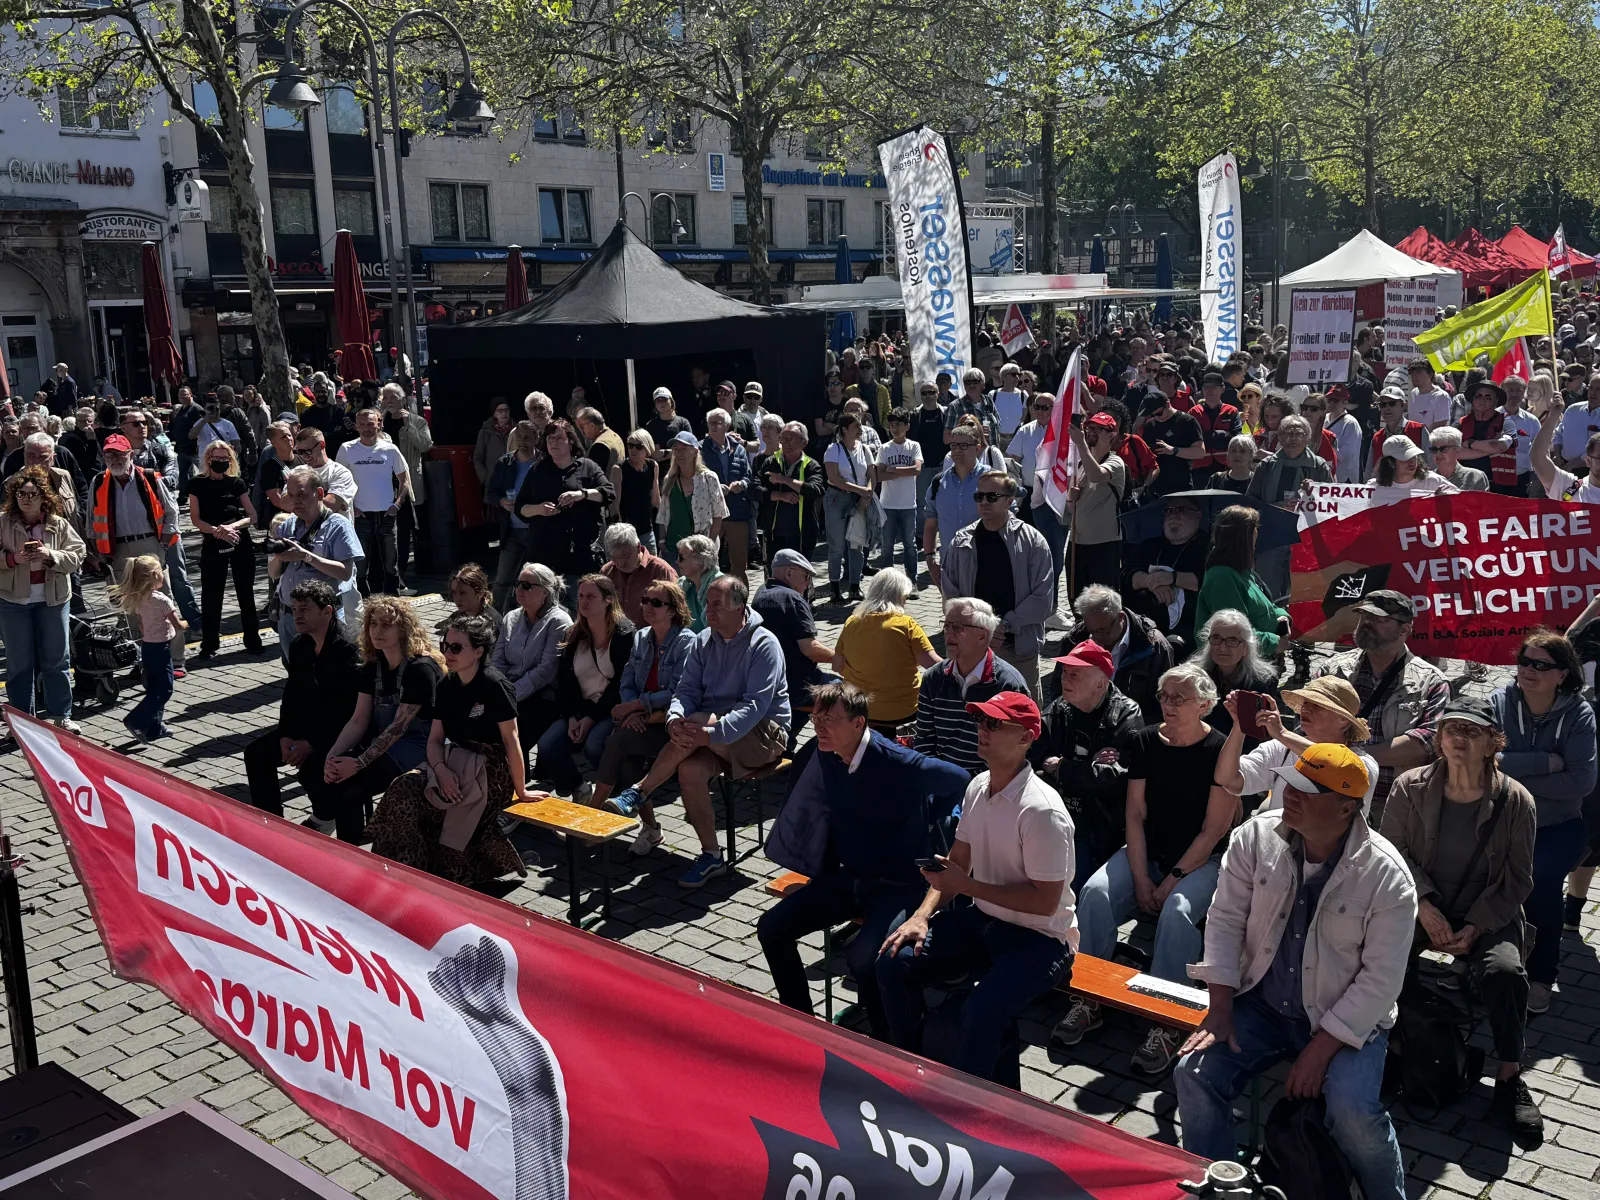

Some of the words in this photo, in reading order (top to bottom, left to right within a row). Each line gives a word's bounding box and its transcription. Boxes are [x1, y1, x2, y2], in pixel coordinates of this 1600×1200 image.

[77, 159, 135, 187] MILANO
[84, 216, 156, 231] RISTORANTE
[96, 228, 147, 239] PIZZERIA
[1418, 280, 1436, 291] Krieg
[1386, 292, 1402, 302] Nein
[1403, 294, 1415, 302] zur
[1416, 295, 1436, 303] neuen
[1413, 306, 1423, 315] der
[1291, 332, 1320, 345] Freiheit
[1324, 332, 1336, 344] für
[1338, 331, 1351, 344] Alle
[1386, 330, 1398, 339] des
[1318, 486, 1376, 499] PRAKT
[1297, 498, 1338, 513] KÖLN
[1397, 517, 1469, 551] FÜR
[1478, 509, 1592, 543] FAIRE
[1402, 546, 1600, 585] VERGÜTUN
[1412, 630, 1429, 640] im
[1433, 629, 1459, 640] B.A.
[1461, 626, 1505, 639] Soziale
